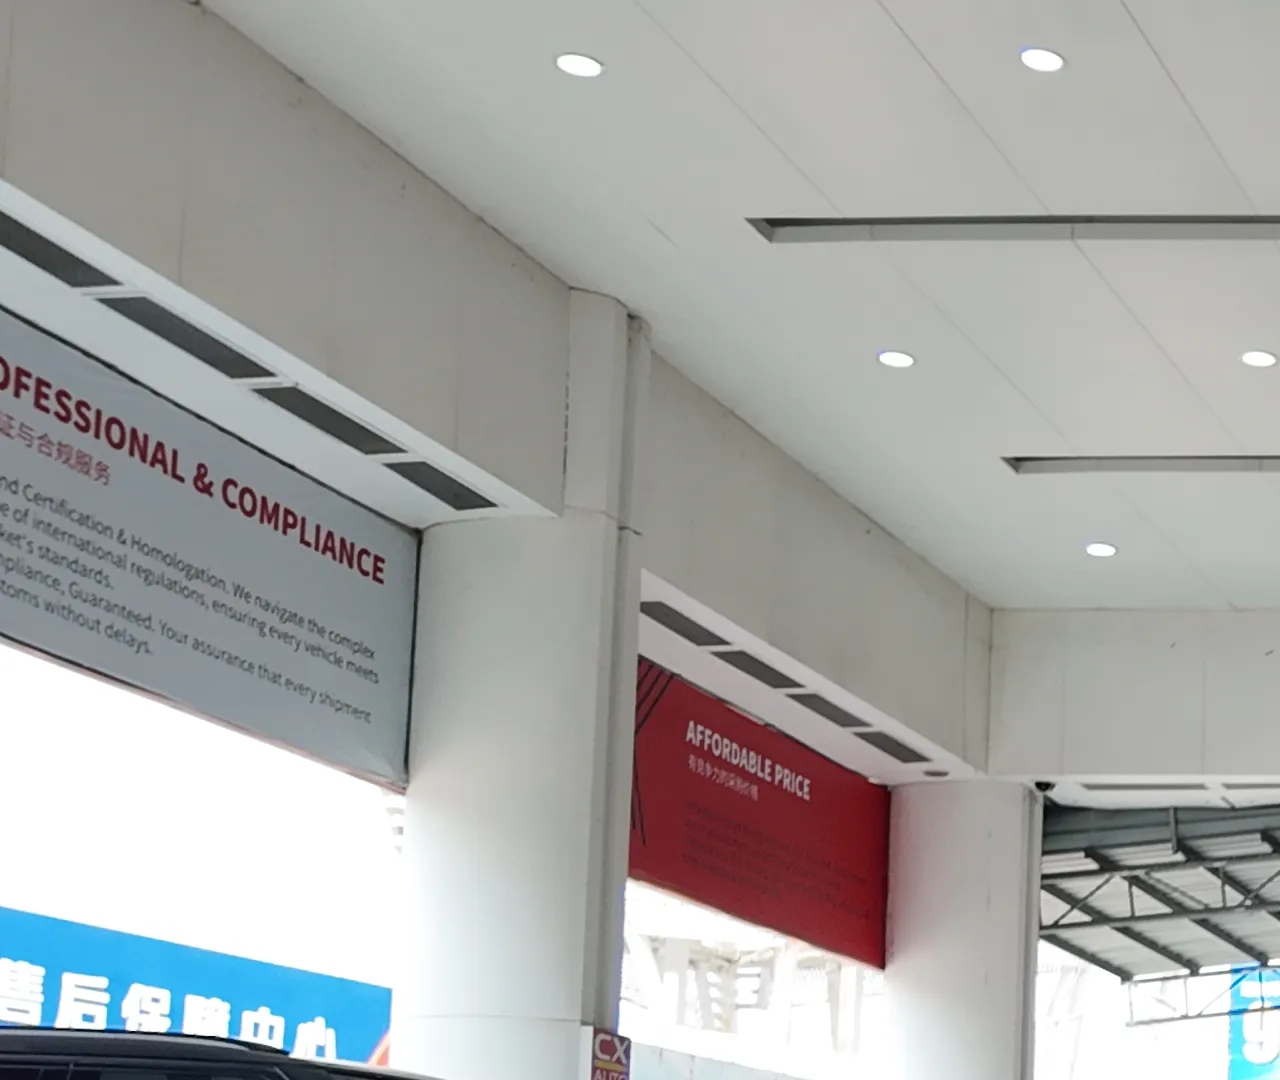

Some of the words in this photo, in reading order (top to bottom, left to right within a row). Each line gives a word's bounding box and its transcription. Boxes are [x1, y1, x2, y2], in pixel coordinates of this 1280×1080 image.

[193, 462, 214, 498] &
[221, 478, 386, 585] COMPLIANCE
[13, 508, 30, 525] of
[33, 512, 127, 571] international
[212, 598, 267, 638] ensuring
[269, 625, 301, 652] every
[304, 639, 343, 669] vehicle
[346, 660, 380, 684] meets
[22, 483, 114, 540] Certification
[116, 528, 127, 546] &
[232, 580, 252, 604] We
[254, 595, 305, 628] navigate
[307, 618, 326, 639] the
[328, 630, 376, 661] complex
[44, 596, 101, 634] without
[159, 618, 188, 645] Your
[192, 637, 254, 675] assurance
[258, 663, 282, 688] that
[284, 676, 317, 704] every
[685, 720, 772, 782] AFFORDABLE
[774, 763, 811, 801] PRICE
[594, 1033, 629, 1065] CX
